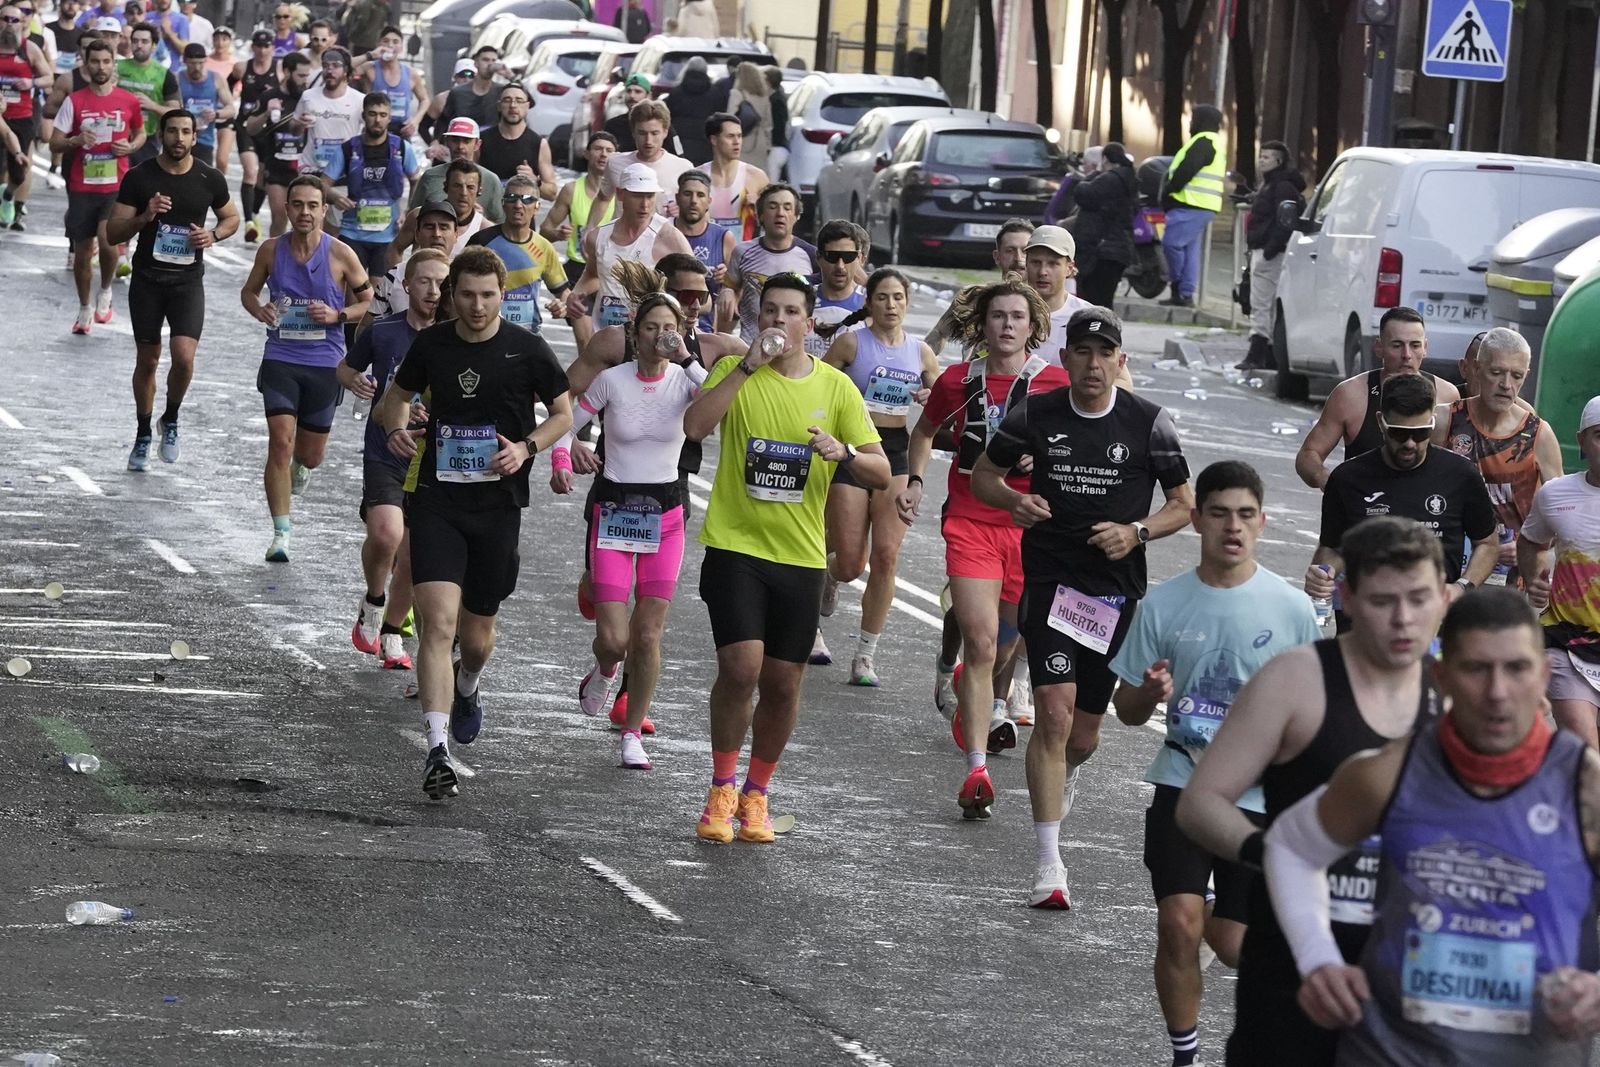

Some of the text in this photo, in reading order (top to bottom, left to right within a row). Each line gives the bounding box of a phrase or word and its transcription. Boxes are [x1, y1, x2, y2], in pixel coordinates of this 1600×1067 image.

[161, 244, 190, 255] SOFIAN
[505, 313, 521, 322] LEO
[1426, 304, 1488, 320] 9177 MFY
[889, 371, 918, 382] ZURICH
[455, 429, 490, 437] ZURICH
[769, 444, 806, 456] ZURICH
[449, 456, 485, 470] QGS18
[767, 461, 788, 472] 4800
[1053, 464, 1119, 477] CLUB ATLETISMO
[754, 471, 797, 489] VICTOR
[621, 516, 640, 526] 7066
[607, 525, 652, 540] EDURNE
[1076, 601, 1097, 616] 9768
[1057, 604, 1108, 637] HUERTAS
[1199, 703, 1229, 717] ZURI
[1449, 913, 1522, 938] ZURICH
[1410, 968, 1521, 1004] DESIUNAI
